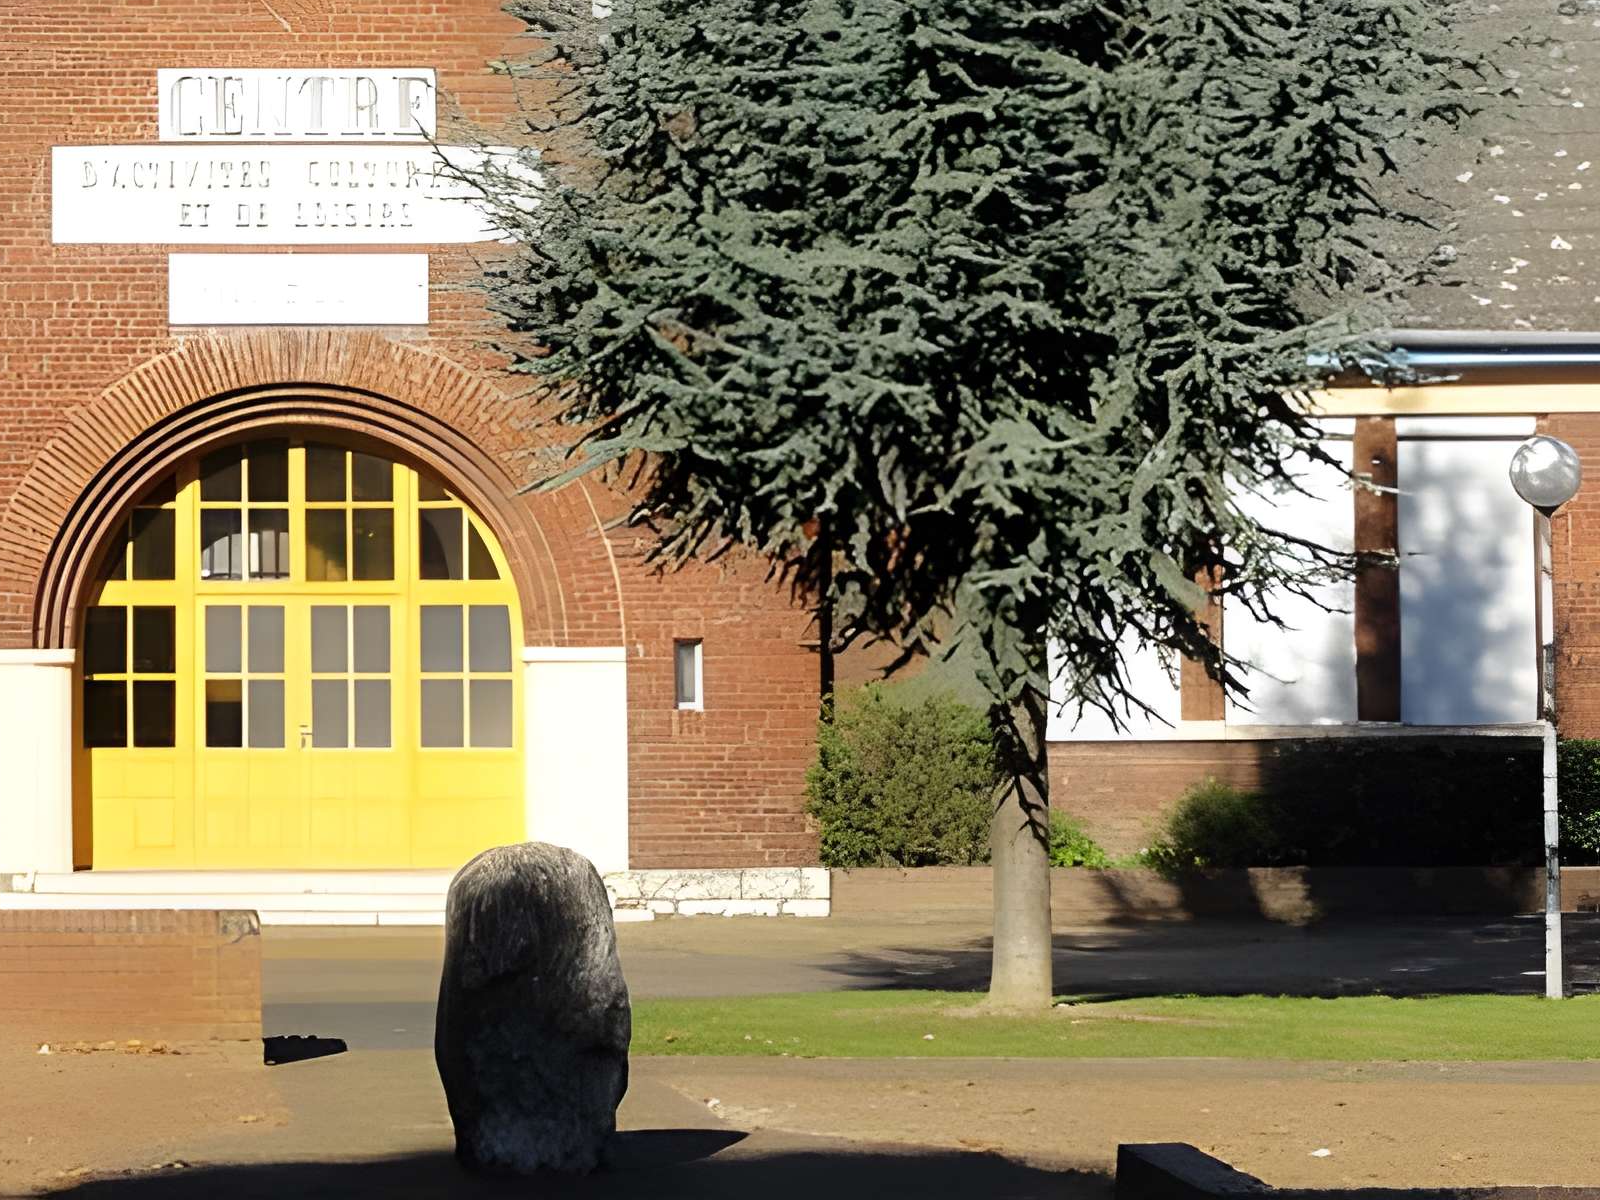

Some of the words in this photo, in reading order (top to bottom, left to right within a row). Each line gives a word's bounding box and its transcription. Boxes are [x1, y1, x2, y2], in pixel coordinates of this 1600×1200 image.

[170, 75, 430, 136] CENTRE
[179, 203, 211, 228] ET
[234, 202, 269, 228] DE
